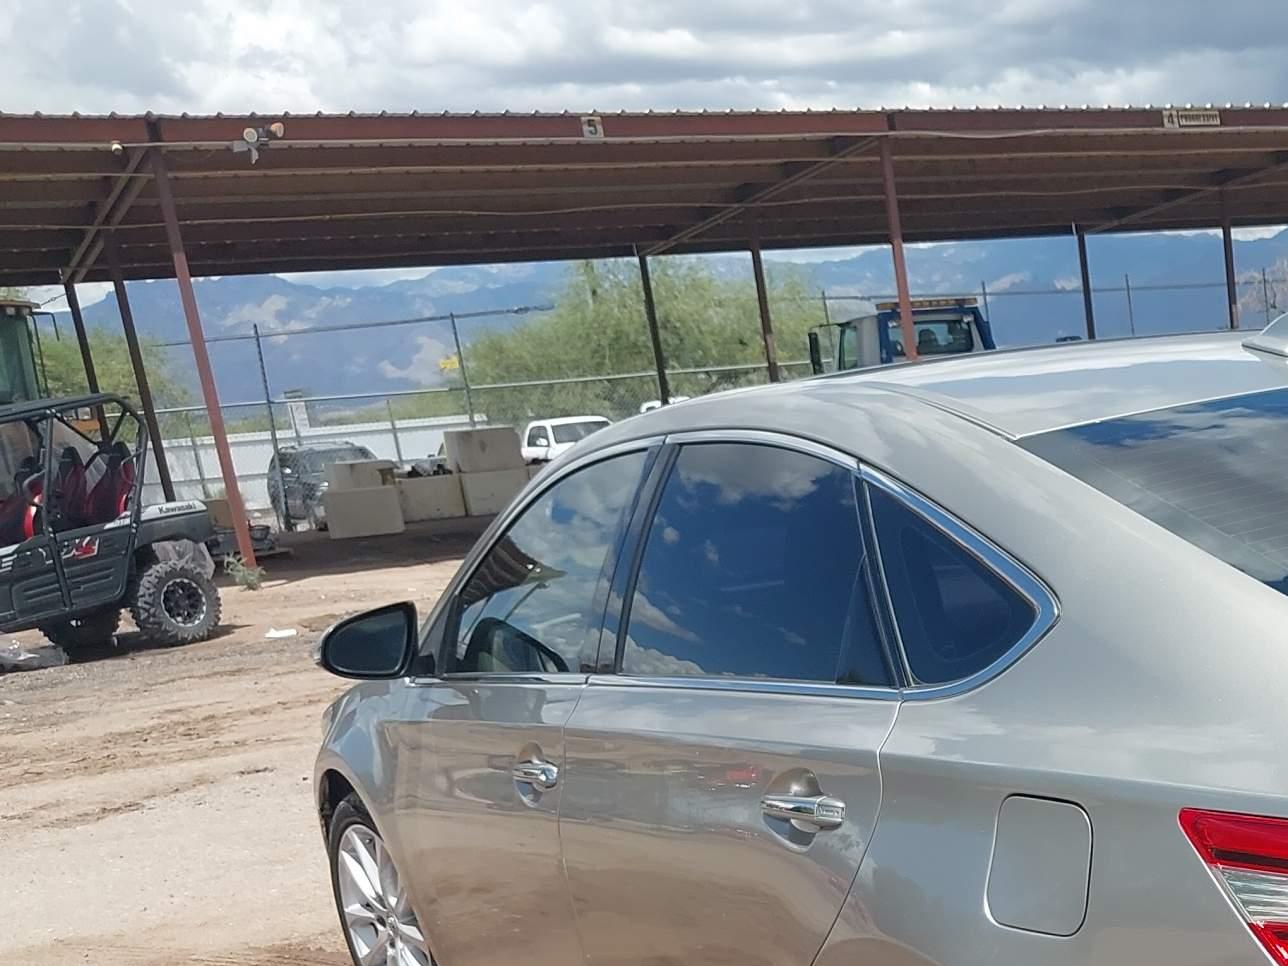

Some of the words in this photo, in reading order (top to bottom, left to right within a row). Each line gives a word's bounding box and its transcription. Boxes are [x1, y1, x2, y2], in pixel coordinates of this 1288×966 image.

[1167, 112, 1175, 124] 4
[587, 119, 598, 135] 5
[157, 502, 197, 515] Kawasaki
